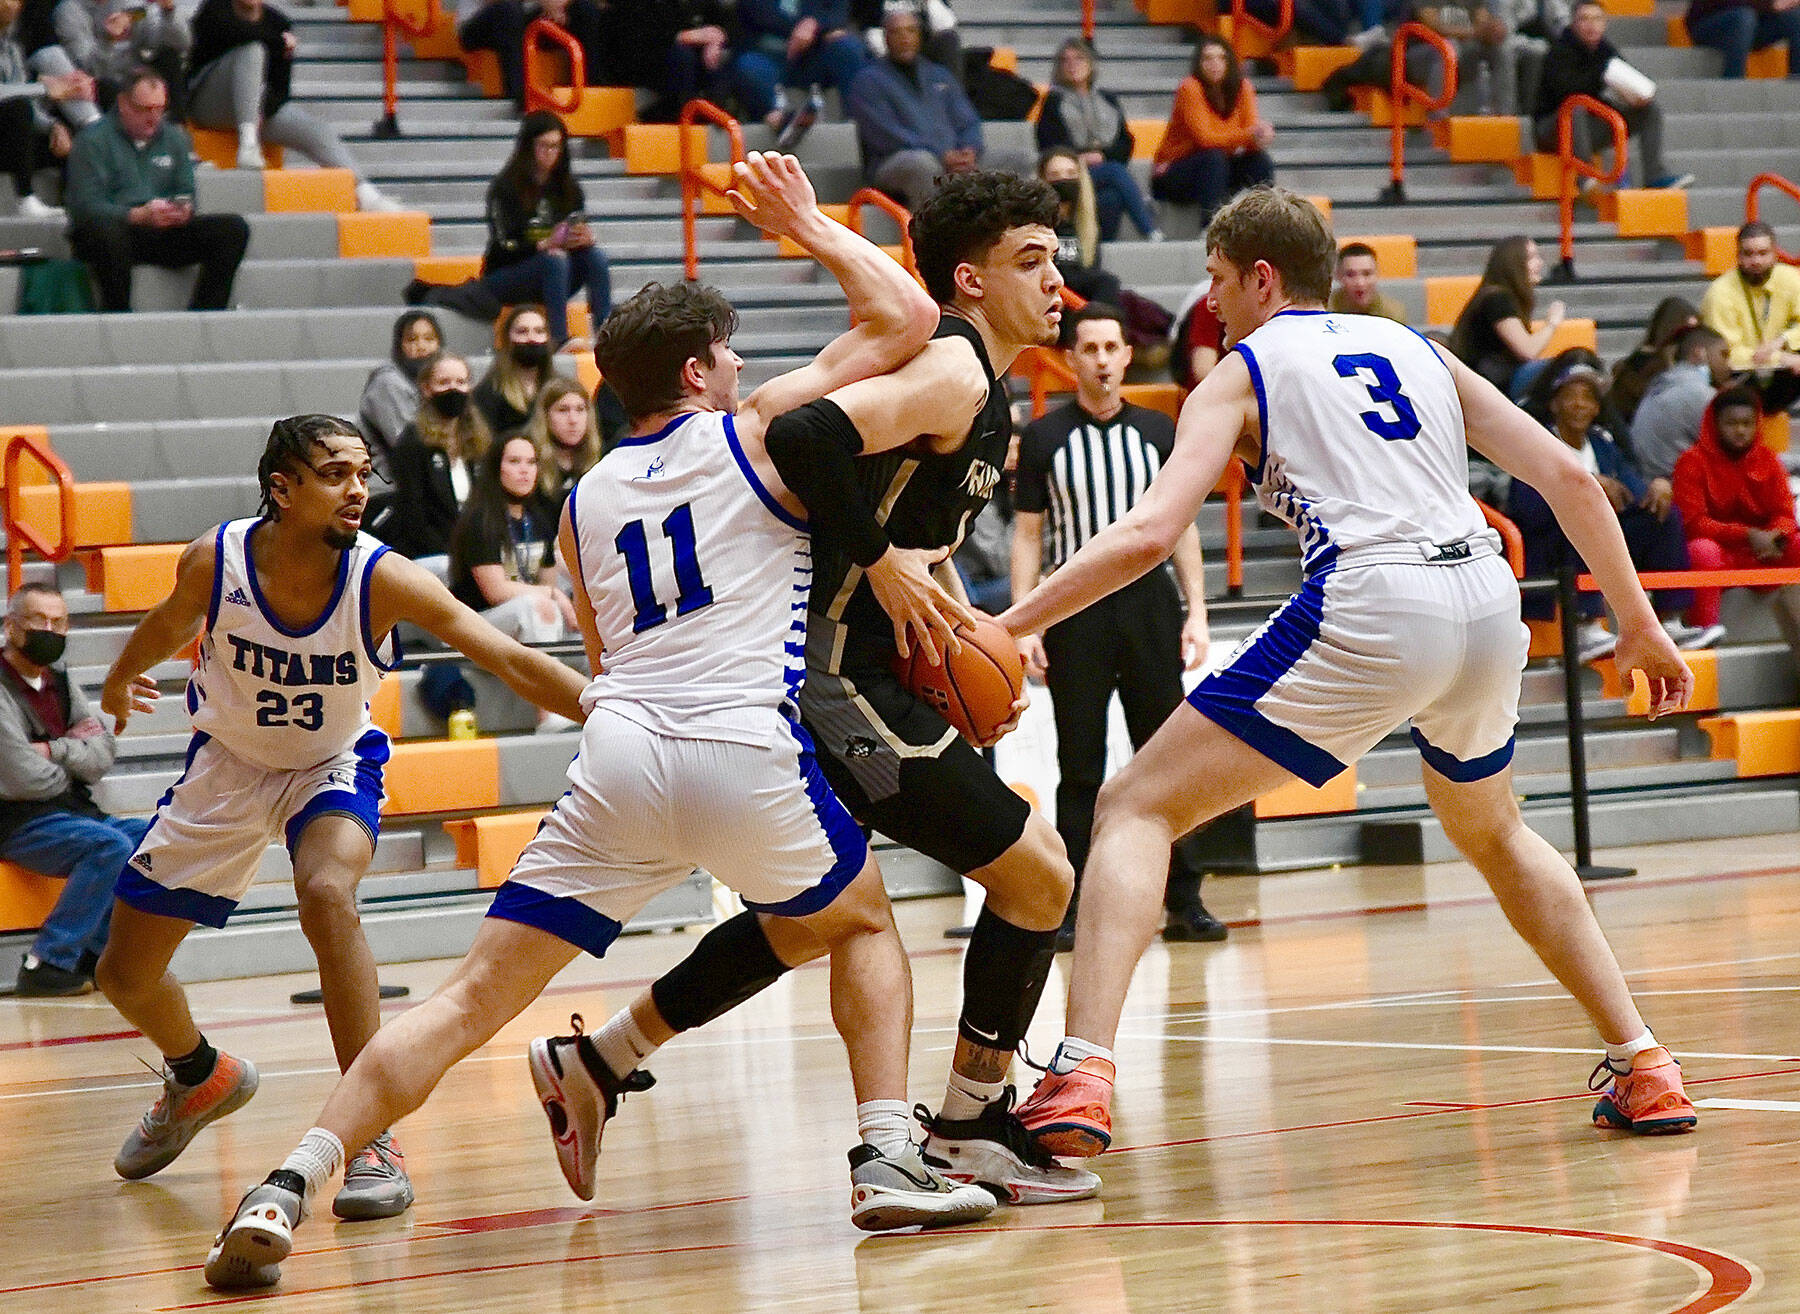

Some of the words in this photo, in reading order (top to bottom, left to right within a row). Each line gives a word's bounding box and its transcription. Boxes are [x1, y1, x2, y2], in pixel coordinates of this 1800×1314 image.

[1332, 352, 1422, 441] 3
[614, 501, 715, 635] 11
[227, 633, 358, 686] TITANS
[256, 689, 324, 731] 23
